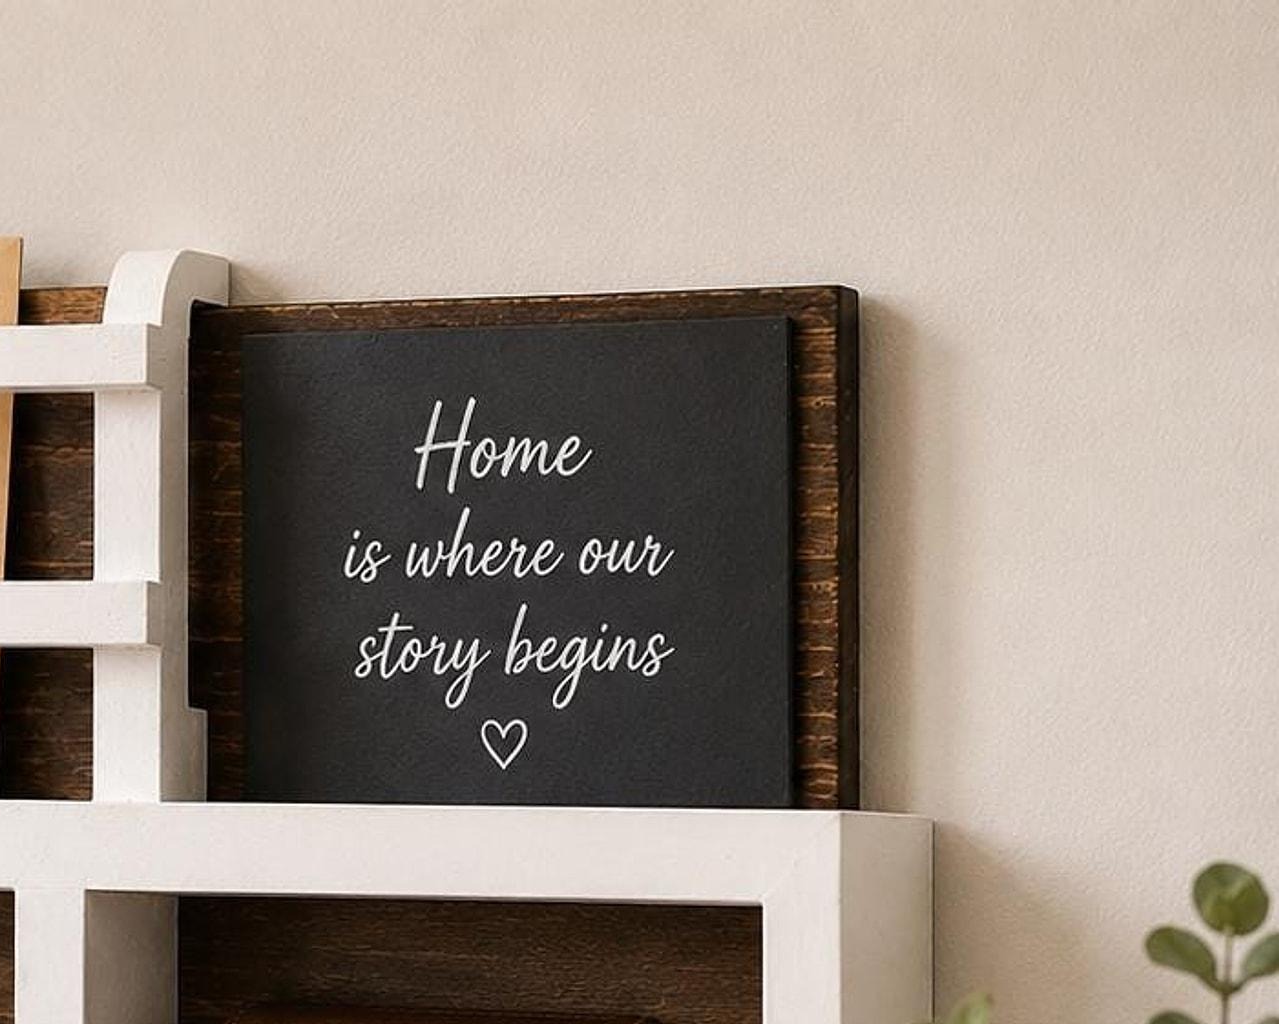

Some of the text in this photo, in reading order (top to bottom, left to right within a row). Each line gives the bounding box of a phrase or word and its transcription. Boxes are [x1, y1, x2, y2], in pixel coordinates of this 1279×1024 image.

[414, 396, 593, 494] Home
[343, 506, 675, 583] is where our
[354, 603, 675, 710] story begins
